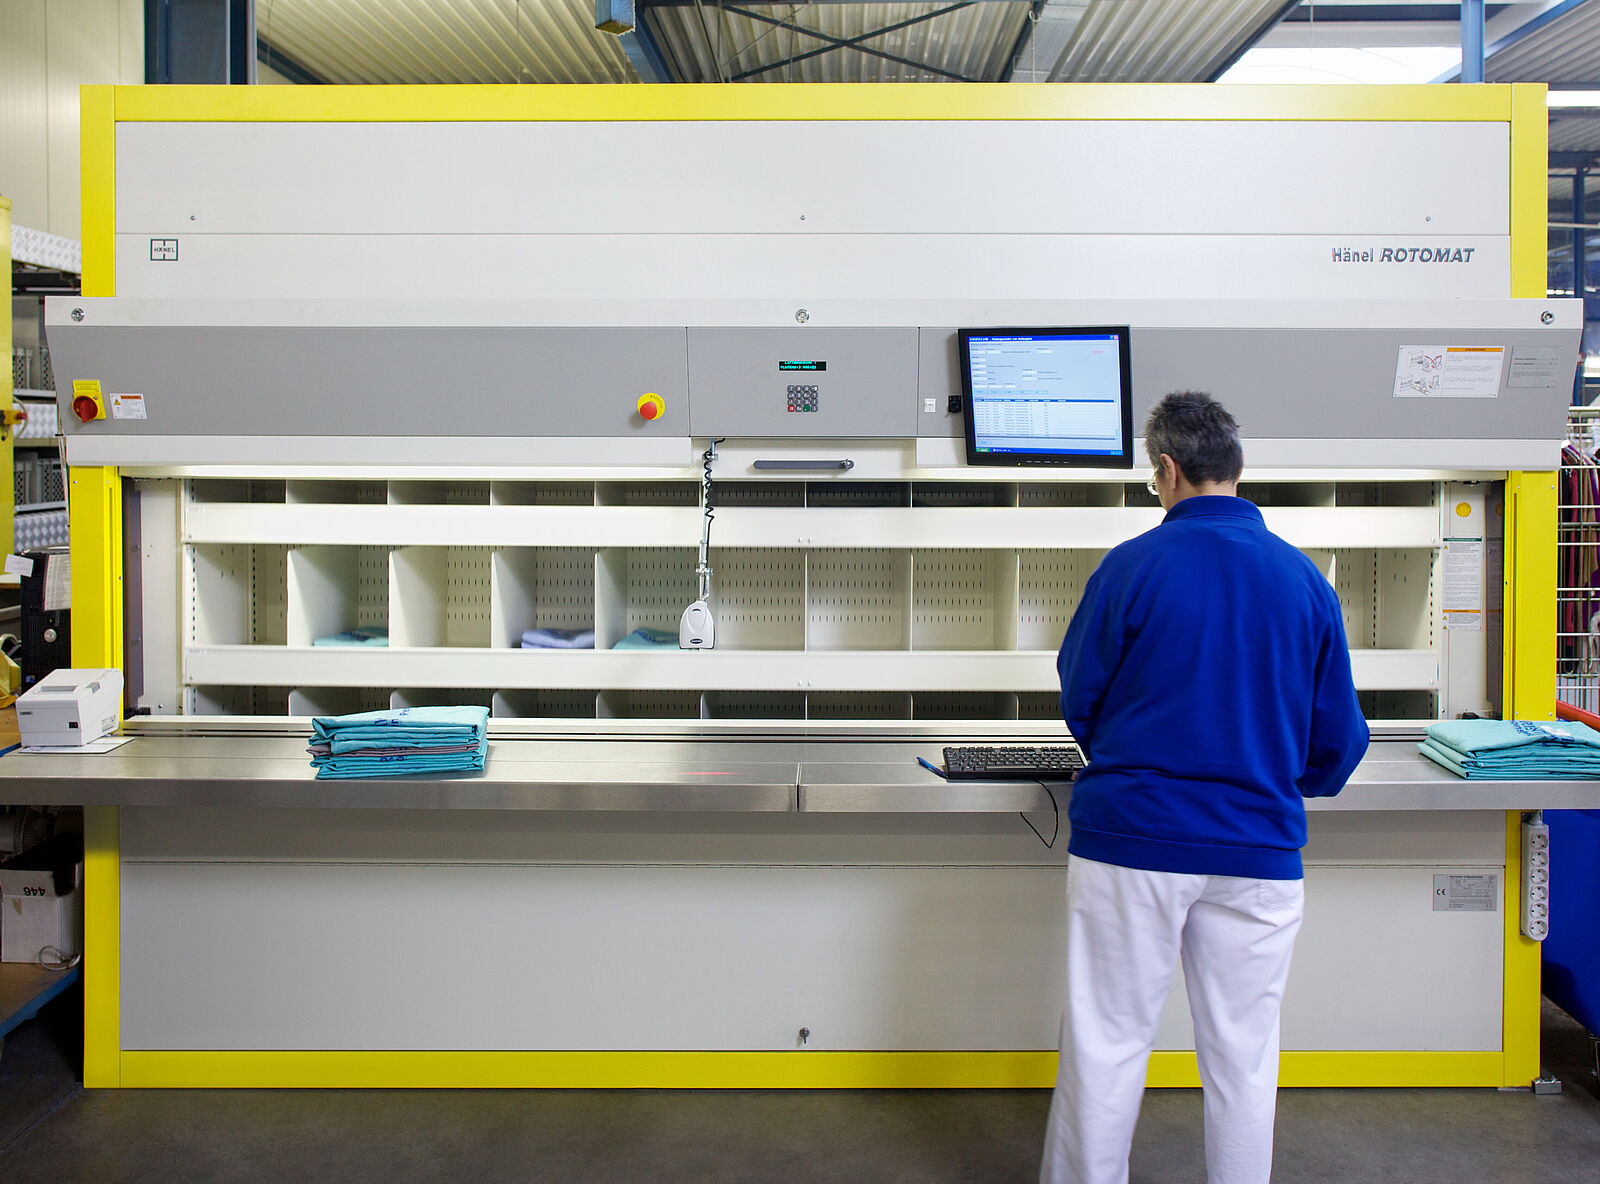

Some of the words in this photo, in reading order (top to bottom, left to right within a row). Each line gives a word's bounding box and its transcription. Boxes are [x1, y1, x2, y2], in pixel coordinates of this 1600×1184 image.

[1332, 247, 1374, 262] Hänel
[1379, 247, 1475, 263] ROTOMAT
[23, 886, 46, 897] 446
